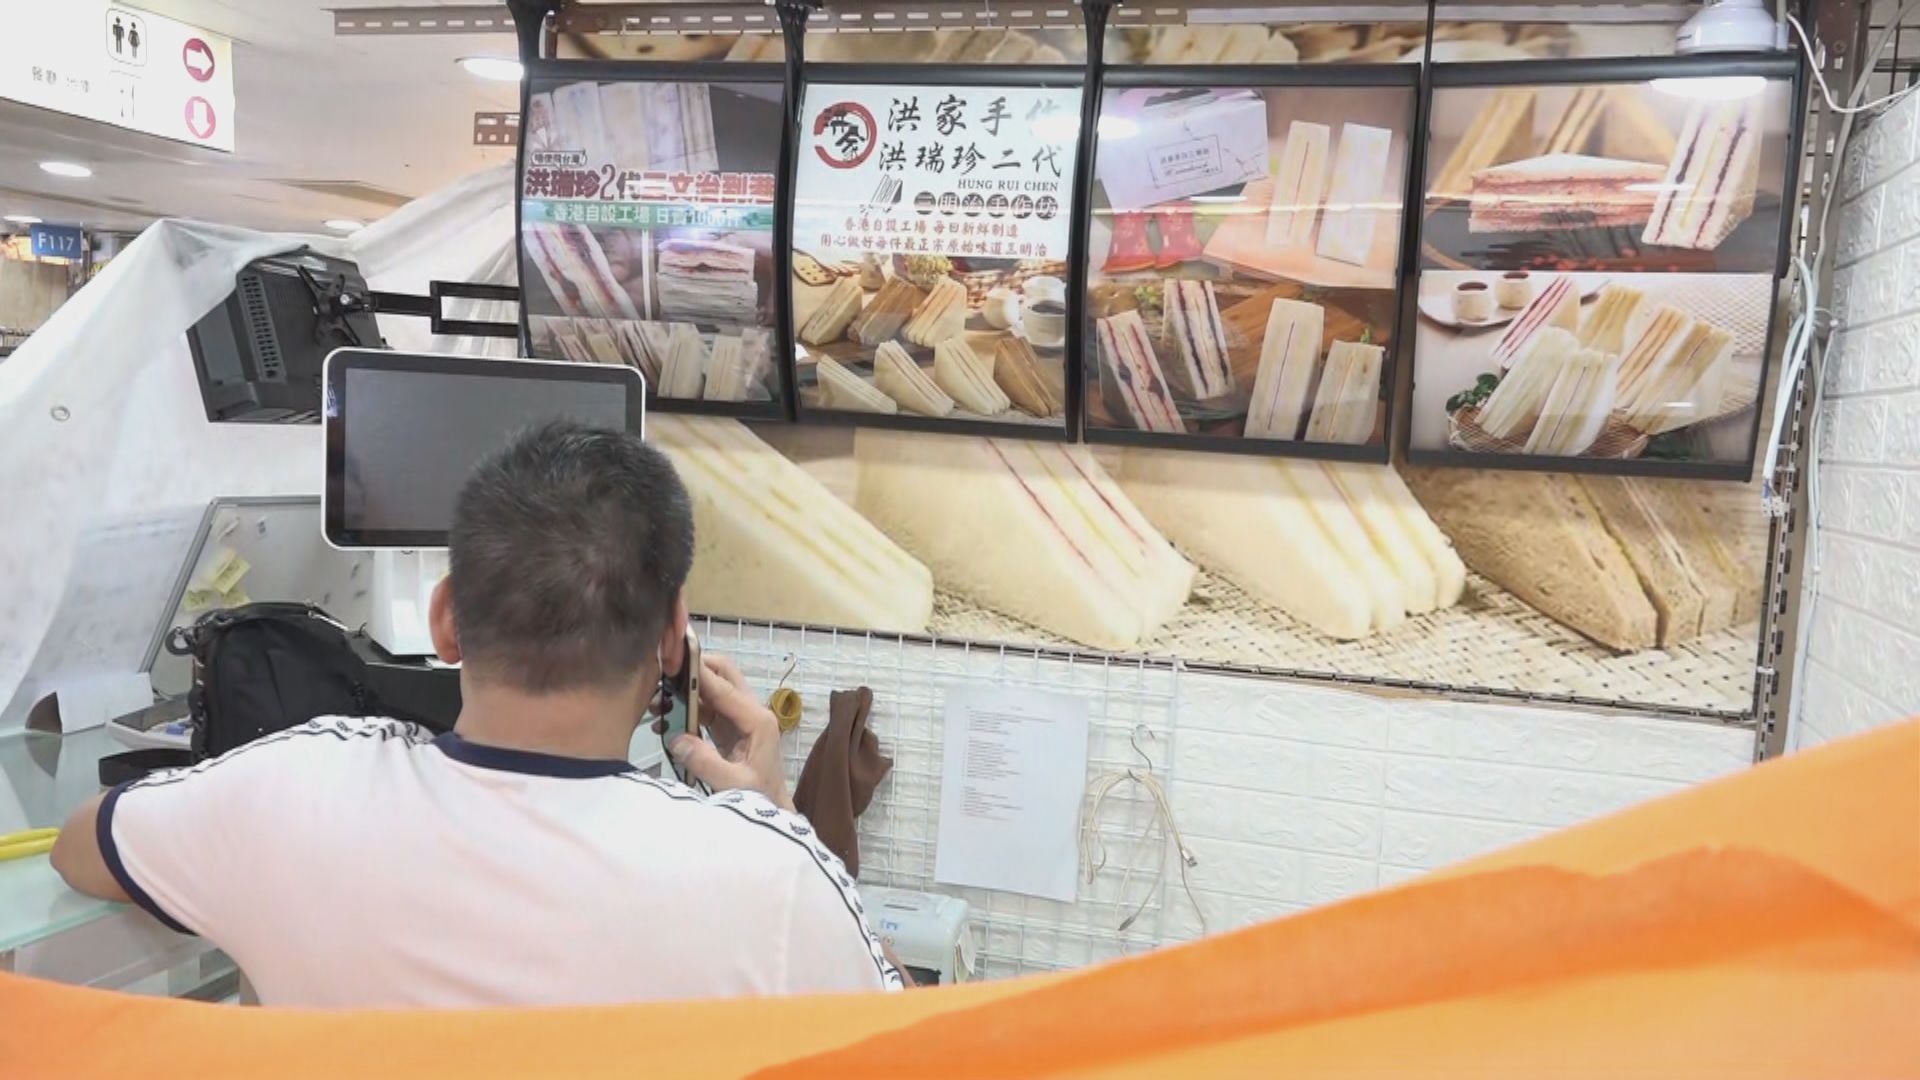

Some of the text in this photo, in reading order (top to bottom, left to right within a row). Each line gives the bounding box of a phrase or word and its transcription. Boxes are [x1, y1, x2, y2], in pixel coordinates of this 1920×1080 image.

[878, 141, 1063, 177] 洪瑞珍二代
[957, 179, 1059, 192] HUNG RUI CHEN
[552, 203, 650, 224] 香港自設工場
[38, 231, 75, 251] F117
